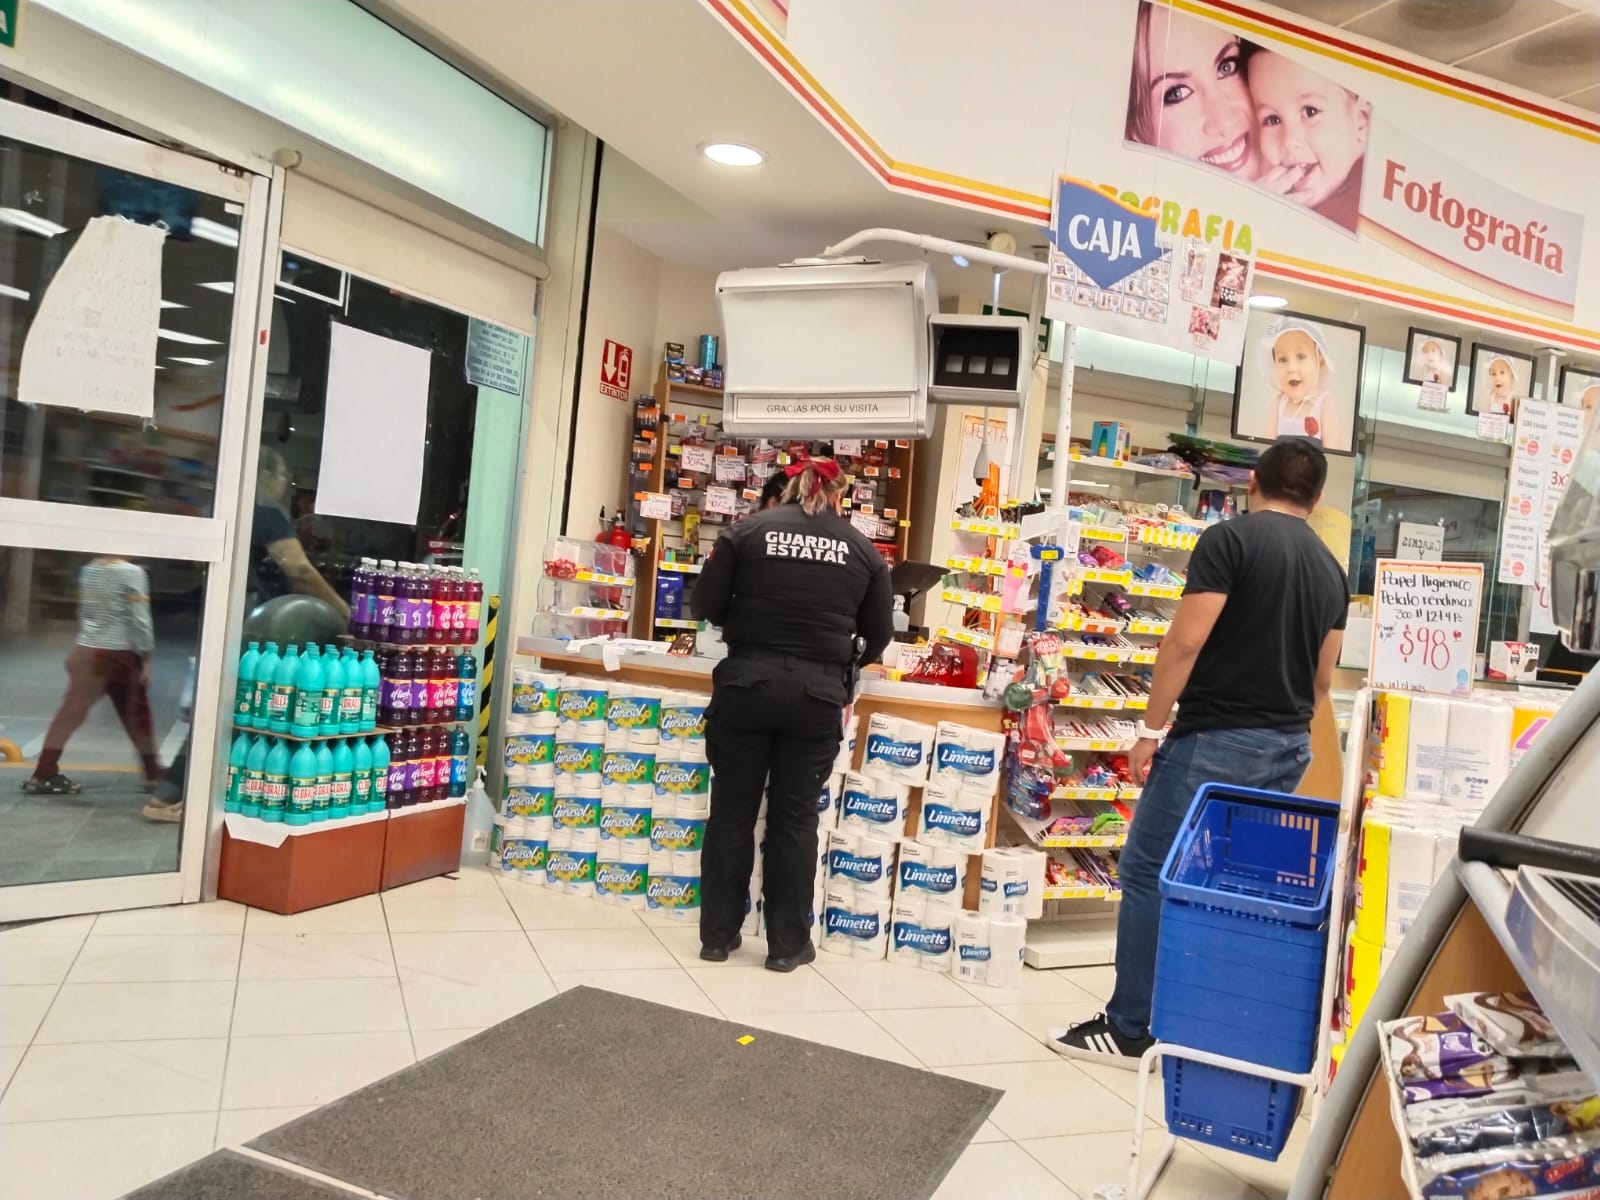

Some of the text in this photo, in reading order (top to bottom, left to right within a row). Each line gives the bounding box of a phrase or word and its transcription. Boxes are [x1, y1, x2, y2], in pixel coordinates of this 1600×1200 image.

[1382, 158, 1564, 275] Fotografía
[1068, 213, 1142, 261] CAJA
[766, 404, 879, 414] GRACIAS POR SU VISITA
[765, 531, 849, 554] GUARDIA
[766, 543, 846, 565] ESTATAL
[1382, 570, 1417, 588] Papel
[560, 696, 593, 711] Girasol
[608, 704, 646, 719] Girasol
[661, 713, 704, 729] Girasol
[505, 740, 542, 756] Girasol
[554, 748, 588, 764] Girasol
[870, 740, 919, 759] Linnette
[940, 749, 992, 766] Linnette
[604, 759, 642, 773] Girasol
[656, 769, 697, 783] Girasol
[507, 792, 540, 807] Girasol
[846, 797, 895, 815] Linnette
[553, 803, 590, 818] Girasol
[928, 808, 977, 827] Linnette
[601, 813, 640, 828] Girasol
[651, 825, 692, 840] Girasol
[503, 845, 539, 860] Girasol
[546, 857, 585, 872] Girasol
[832, 856, 880, 873] Linnette
[596, 869, 637, 884] Girasol
[903, 868, 954, 884] Linnette
[647, 882, 690, 897] Girasol
[828, 914, 876, 931] Linnette
[897, 929, 948, 945] Linnette
